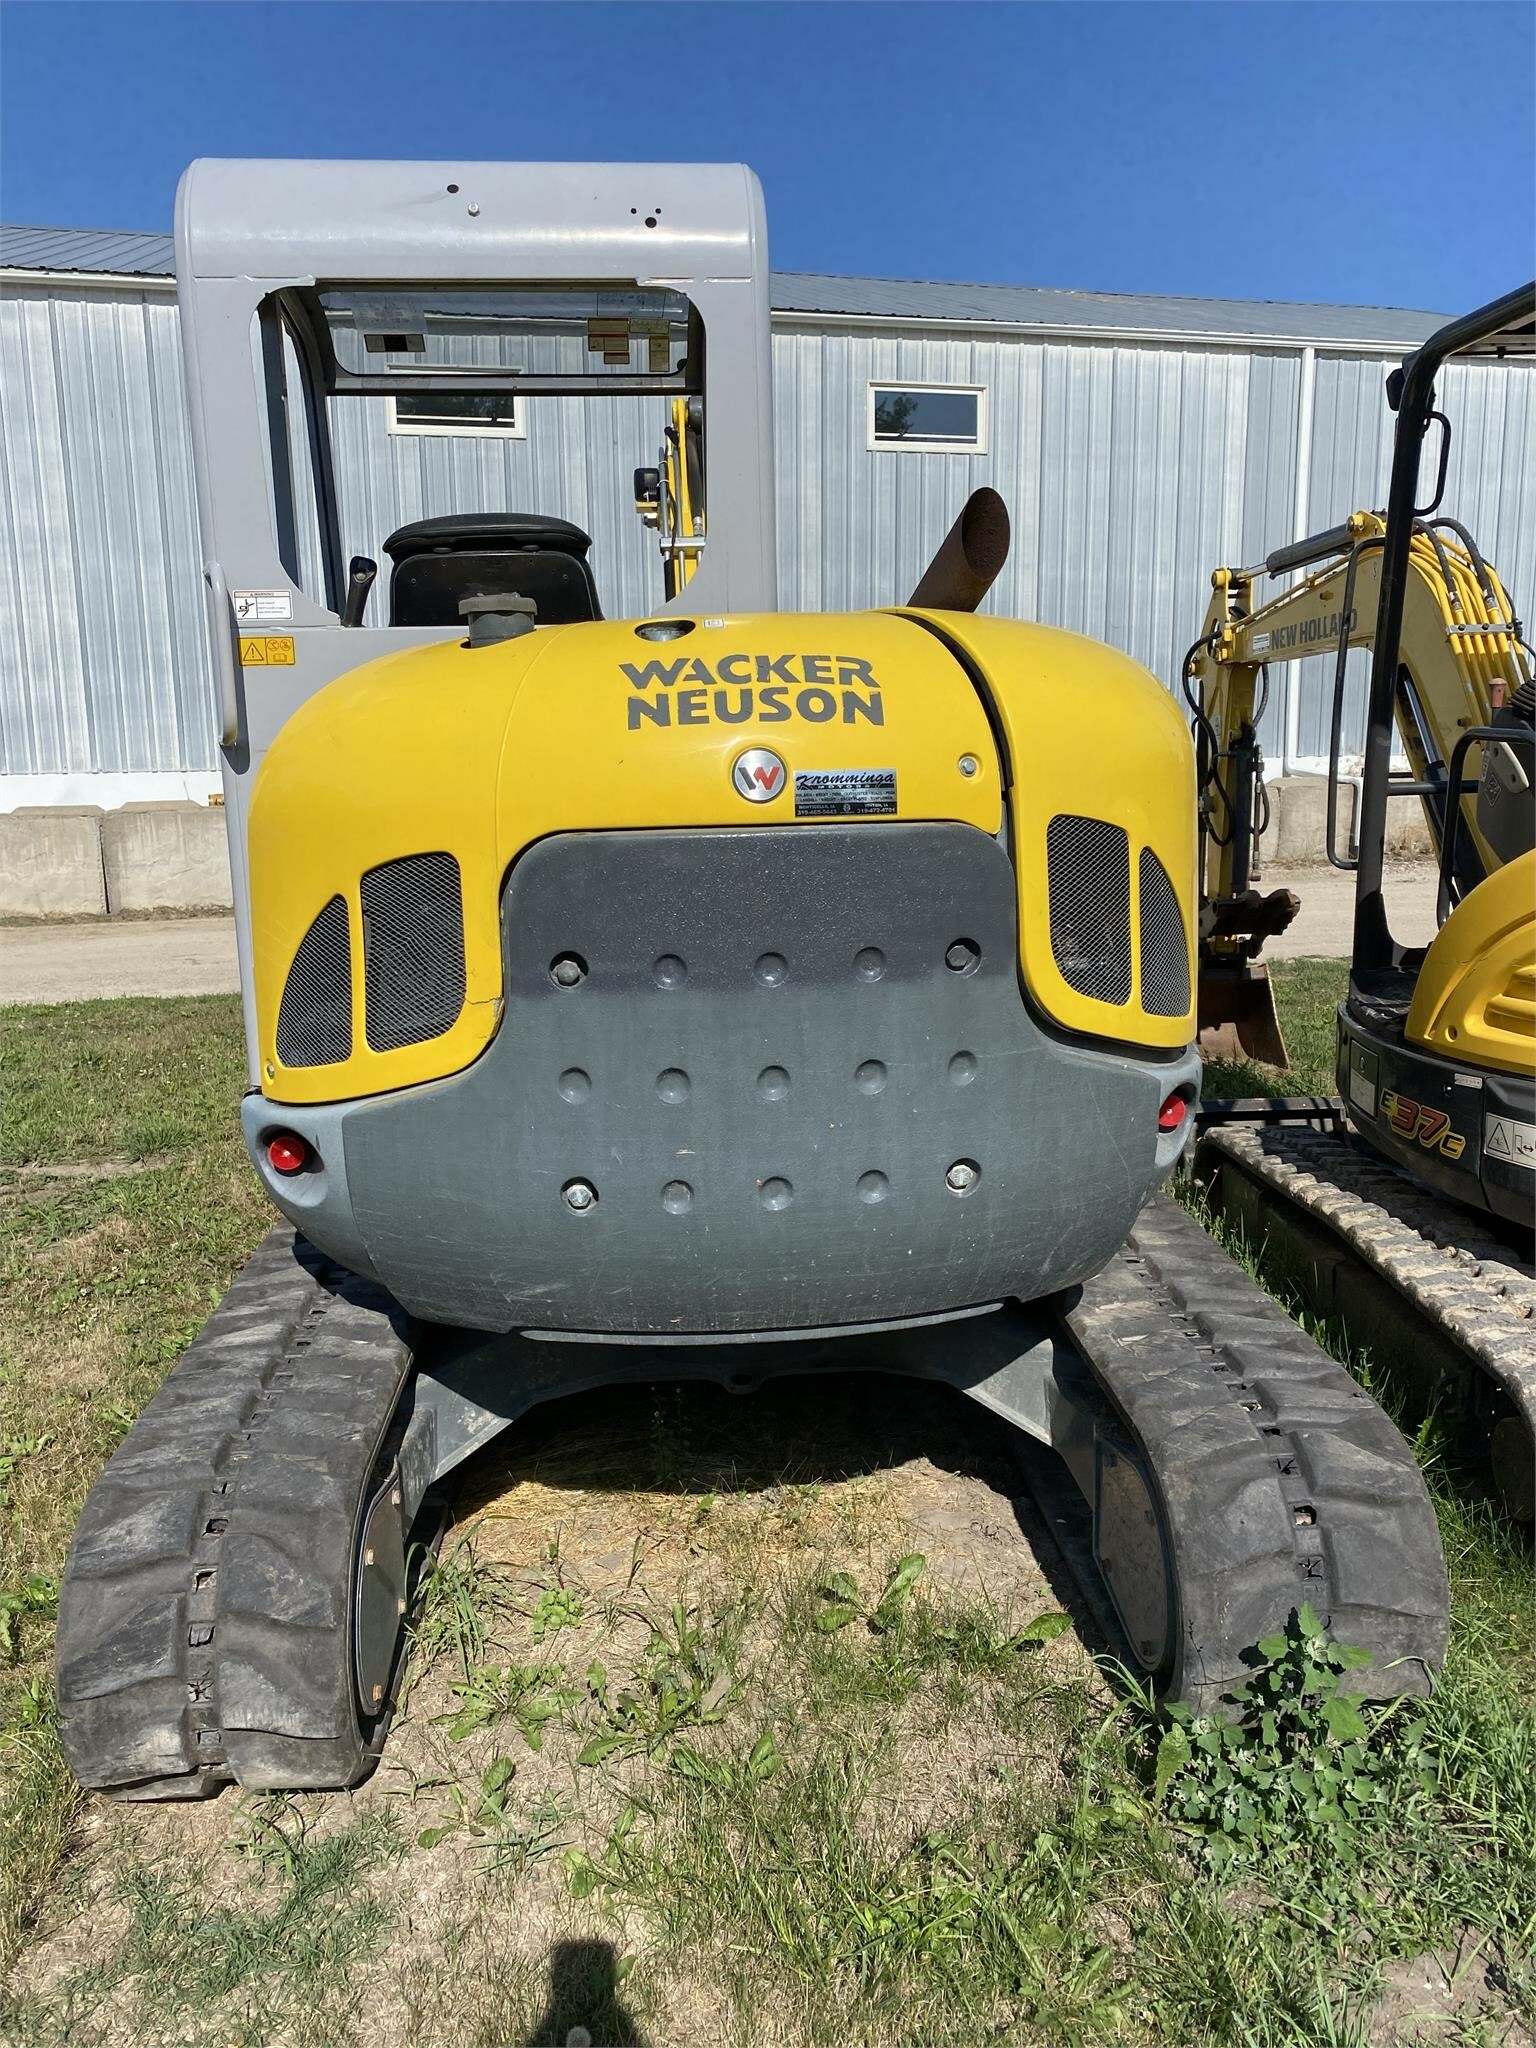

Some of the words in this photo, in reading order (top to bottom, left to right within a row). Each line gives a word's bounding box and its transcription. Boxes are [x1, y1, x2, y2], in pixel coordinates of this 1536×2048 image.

[1271, 624, 1297, 650] NEW
[619, 654, 881, 689] WACKER
[627, 687, 885, 730] NEUSON
[796, 772, 895, 790] Kromminga
